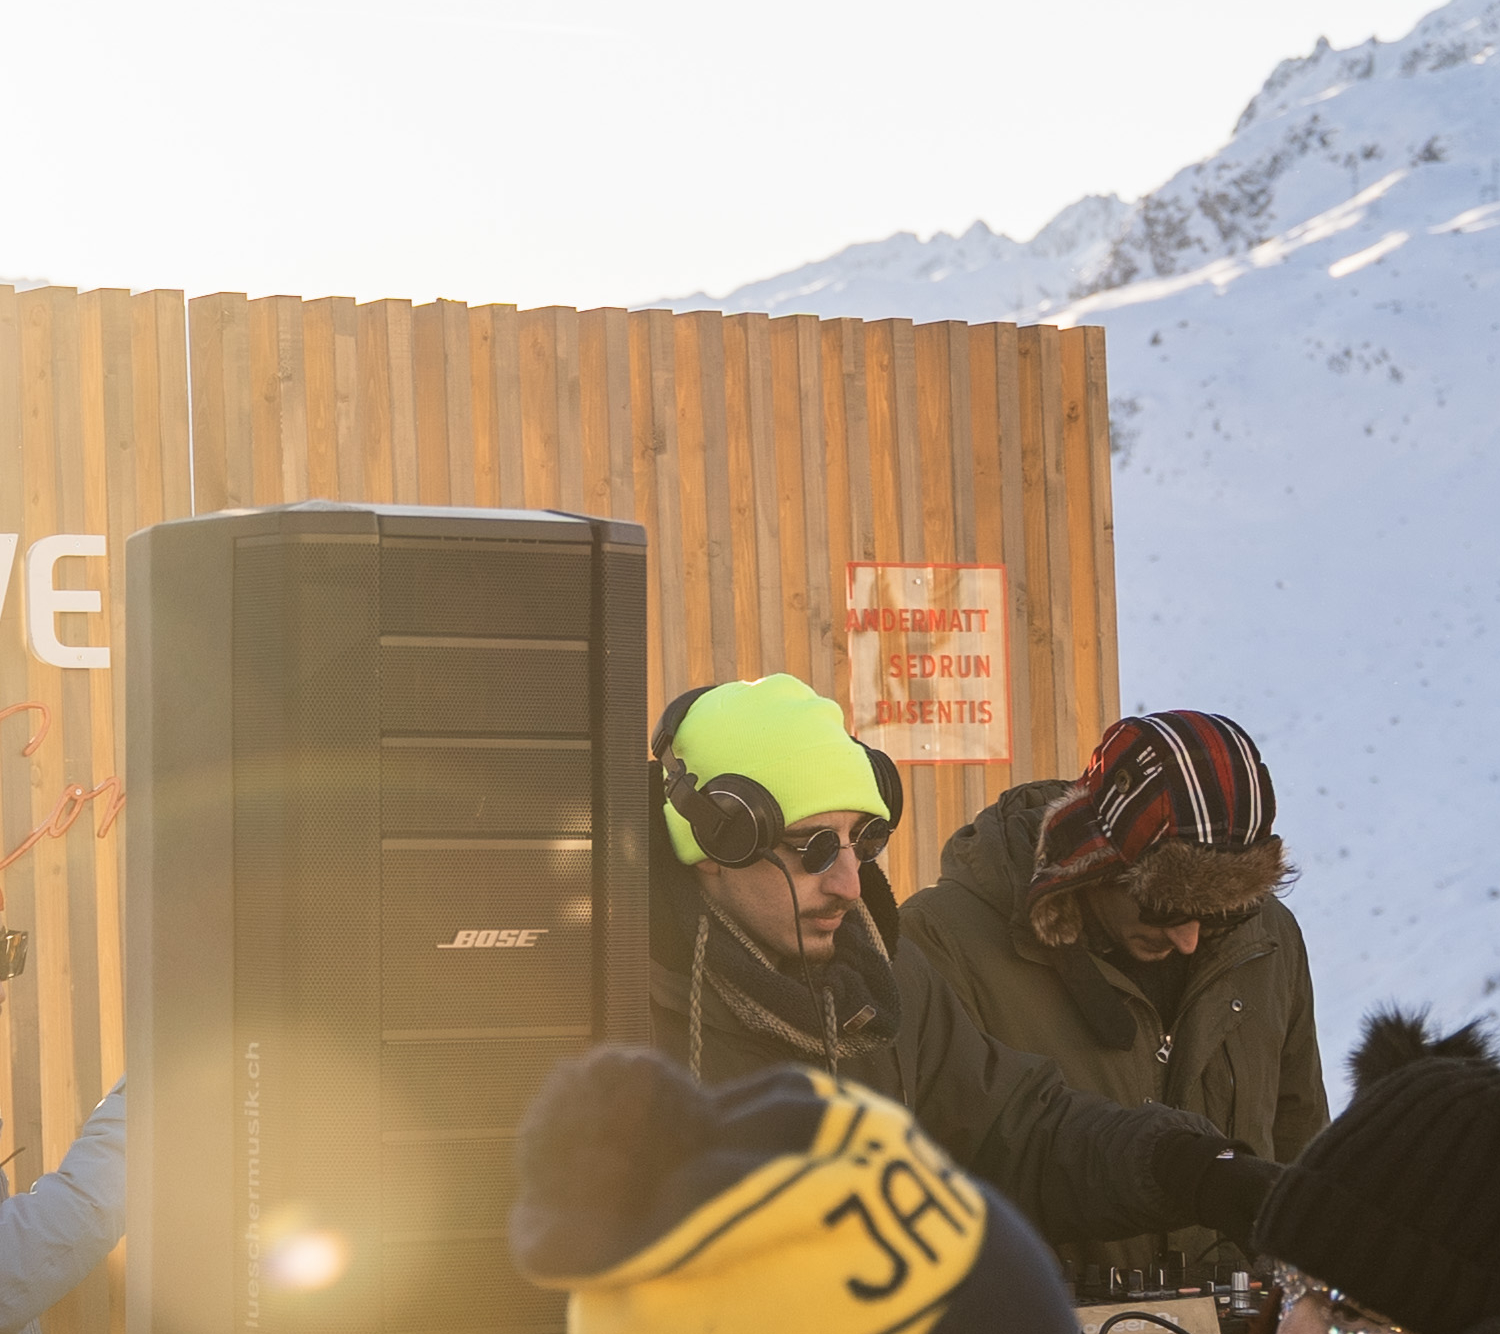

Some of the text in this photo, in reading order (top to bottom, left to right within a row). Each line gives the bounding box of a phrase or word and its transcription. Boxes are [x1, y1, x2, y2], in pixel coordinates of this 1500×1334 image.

[844, 608, 989, 633] ANDERMATT
[889, 654, 991, 679] SEDRUN
[876, 699, 993, 725] DISENTIS
[437, 929, 549, 949] BOSE
[245, 1041, 260, 1328] lueschermusik.ch
